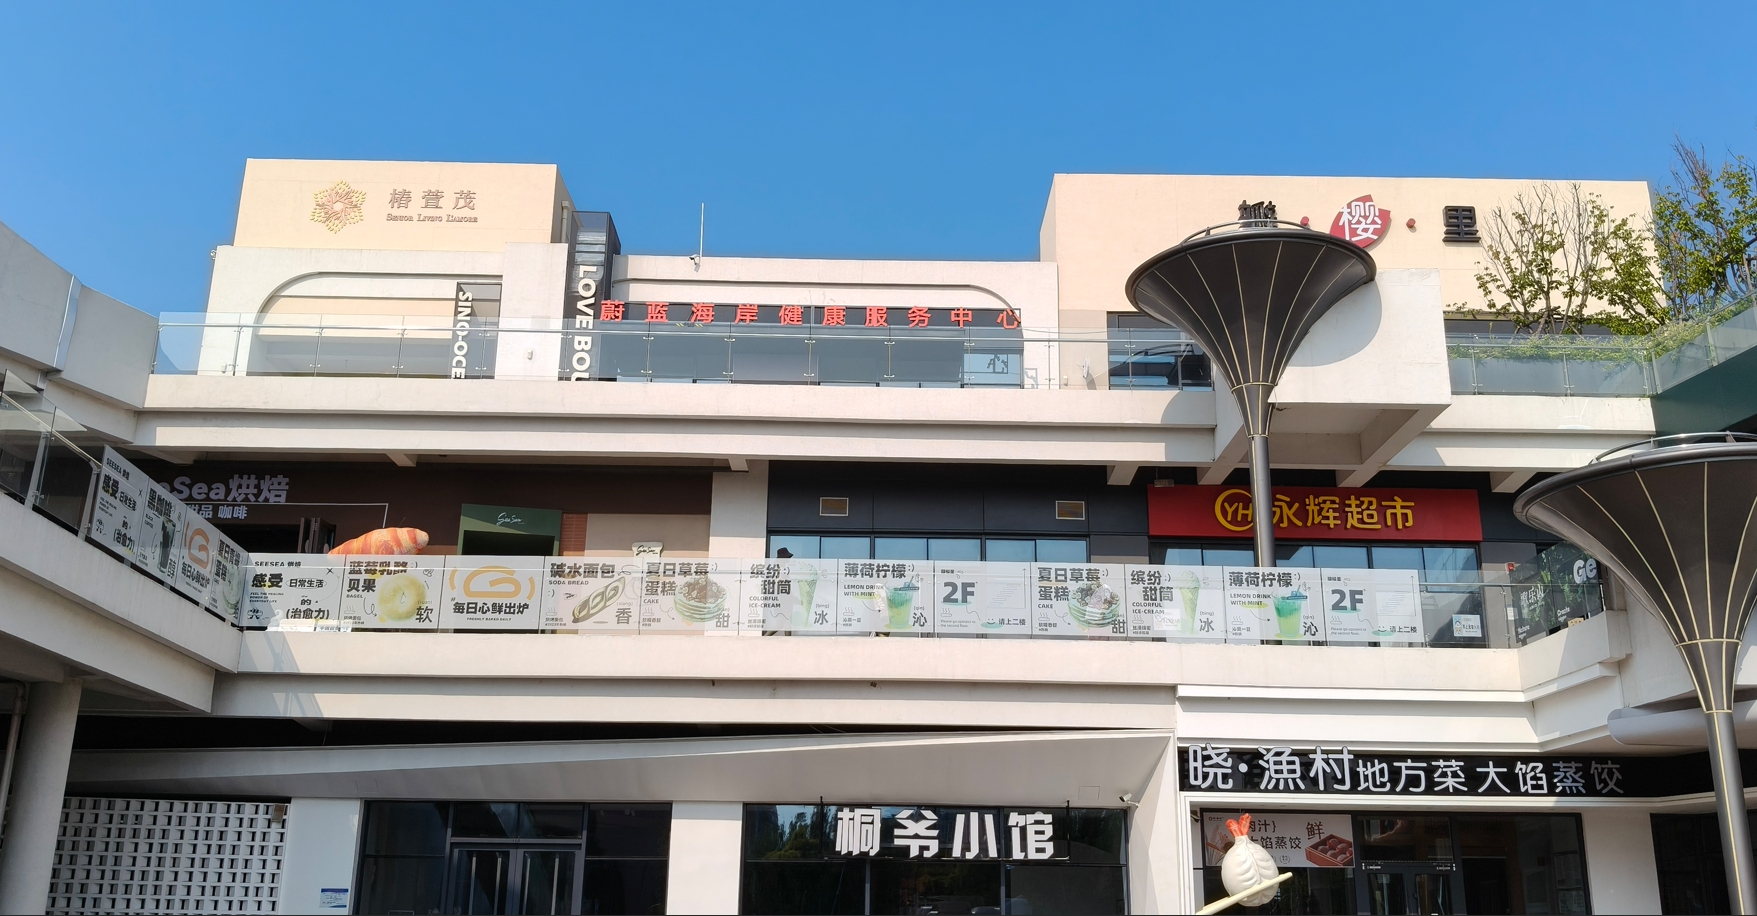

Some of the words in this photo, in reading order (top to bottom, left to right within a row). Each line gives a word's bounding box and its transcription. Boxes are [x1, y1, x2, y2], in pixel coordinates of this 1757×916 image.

[388, 188, 477, 211] 椿萱茂
[575, 265, 598, 330] LOVE
[599, 299, 1022, 330] 蔚蓝海岸健康服务中心
[451, 291, 473, 379] SINO-OCE
[101, 473, 120, 500] 感受
[119, 491, 137, 512] 日常生活
[147, 487, 173, 519] 黑咖啡
[217, 504, 248, 519] 咖啡
[1223, 501, 1252, 522] YH
[1272, 493, 1415, 530] 永辉超市
[121, 519, 129, 530] 的
[181, 560, 211, 590] 每日心鲜出炉
[348, 561, 408, 576] 蓝莓乳酪
[550, 562, 615, 579] 碱水面包
[645, 562, 709, 578] 夏日草莓
[749, 563, 780, 579] 缤纷
[844, 562, 907, 579] 薄荷柠檬
[1038, 567, 1101, 583] 夏日草莓
[1573, 558, 1597, 584] Ge
[251, 572, 283, 588] 感受
[289, 578, 324, 588] 日常生活
[1130, 569, 1162, 585] 缤纷
[1228, 571, 1293, 588] 薄荷柠檬
[347, 578, 376, 593] 贝果
[645, 581, 677, 596] 蛋糕
[761, 579, 792, 595] 甜筒
[942, 581, 976, 604] 2F
[1038, 585, 1070, 601] 蛋糕
[1142, 586, 1174, 602] 甜筒
[1331, 588, 1364, 611] 2F
[415, 605, 434, 623] 软
[453, 601, 530, 615] 每日心鲜出炉
[615, 607, 632, 625] 香
[715, 612, 731, 628] 甜
[813, 609, 829, 625] 冰
[912, 612, 928, 627] 沁
[998, 618, 1026, 626] 请上二楼
[1199, 617, 1215, 633] 冰
[1110, 618, 1126, 634] 甜
[1303, 621, 1319, 637] 沁
[1389, 625, 1418, 633] 请上二楼
[835, 806, 1054, 860] 桐爷小馆
[1305, 820, 1325, 840] 鲜
